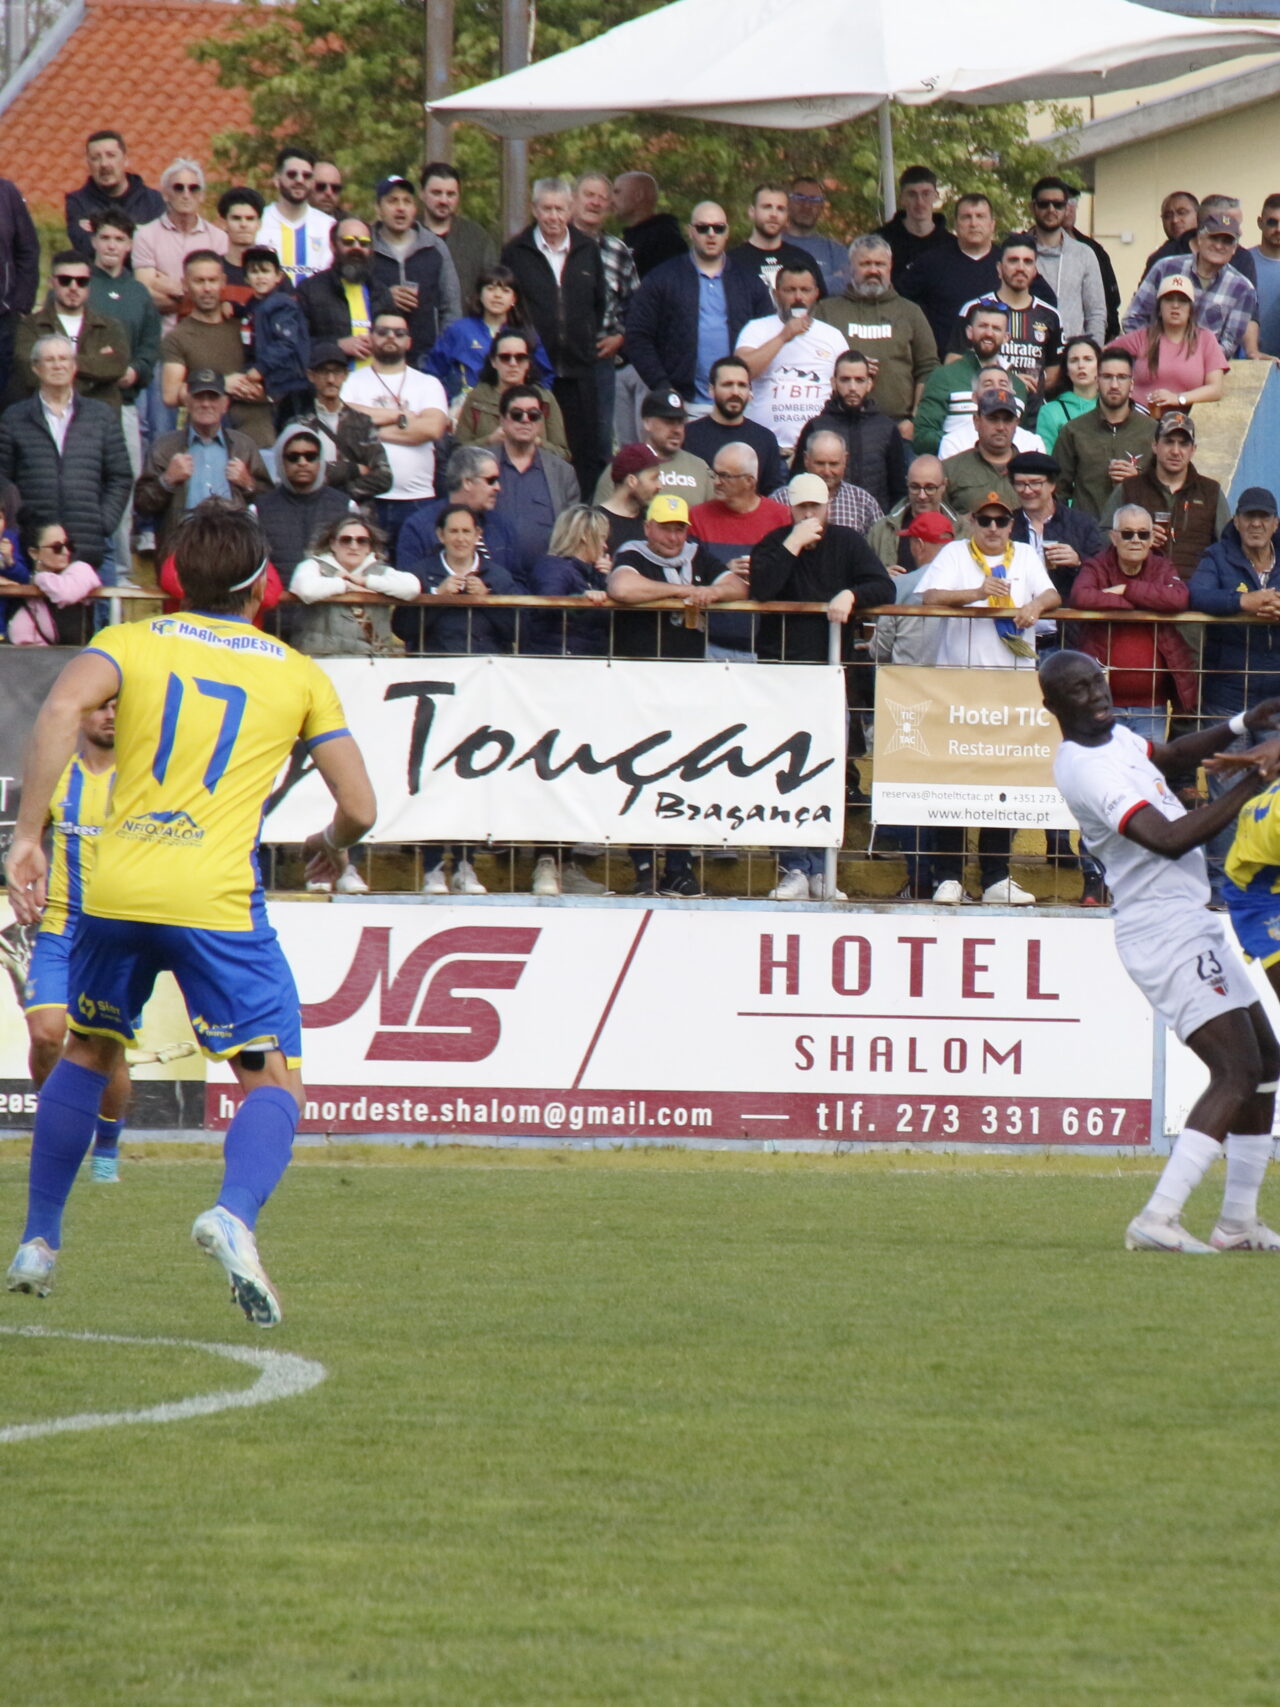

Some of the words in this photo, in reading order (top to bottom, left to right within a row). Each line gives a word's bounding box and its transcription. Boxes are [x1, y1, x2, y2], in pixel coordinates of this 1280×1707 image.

[848, 322, 892, 339] PUMA
[789, 384, 822, 399] BTT
[658, 470, 697, 488] idas
[949, 705, 1009, 727] Hotel
[1016, 706, 1051, 727] TIC
[152, 671, 248, 795] 17
[383, 680, 836, 816] Touças
[948, 739, 1051, 758] Restaurante
[881, 789, 994, 803] reservas@hoteltictac.pt
[654, 792, 833, 830] Bragança
[927, 808, 1051, 823] www.hoteltictac.pt
[759, 933, 1060, 1000] HOTEL
[1196, 950, 1223, 981] 23
[794, 1034, 1022, 1075] SHALOM
[220, 1093, 713, 1129] hnordeste.shalom@gmail.com
[816, 1100, 876, 1132] tlf.
[896, 1103, 960, 1134] 273
[981, 1105, 1040, 1134] 331
[1061, 1107, 1126, 1136] 667
